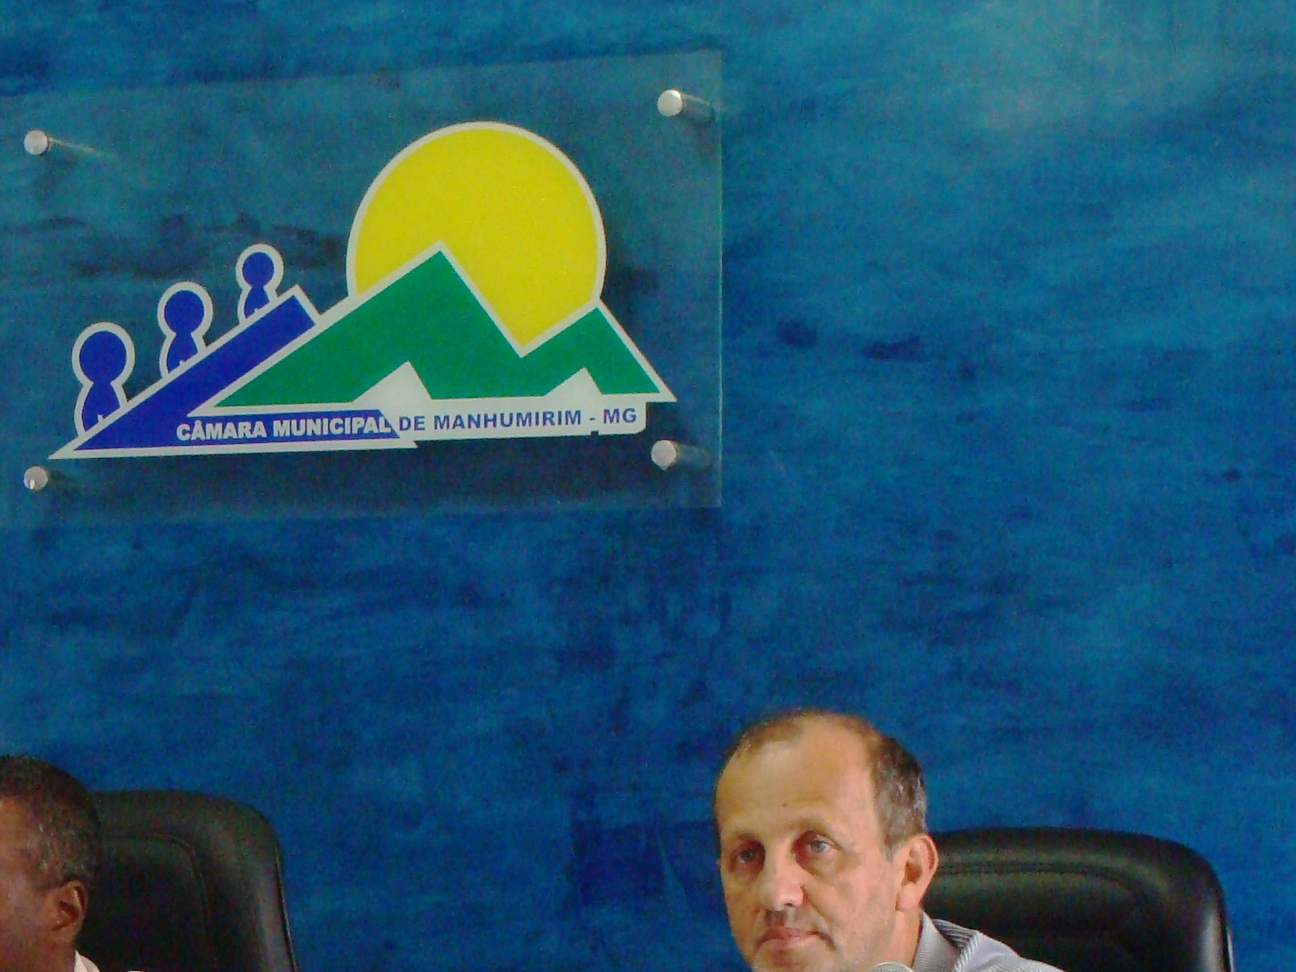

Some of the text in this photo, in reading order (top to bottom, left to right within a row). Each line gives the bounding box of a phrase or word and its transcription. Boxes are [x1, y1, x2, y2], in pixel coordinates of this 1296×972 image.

[176, 420, 267, 441] CÂMARA
[273, 416, 392, 438] MUNICIPAL
[398, 414, 426, 432] DE
[433, 409, 582, 431] MANHUMIRIM
[602, 407, 637, 425] MG
